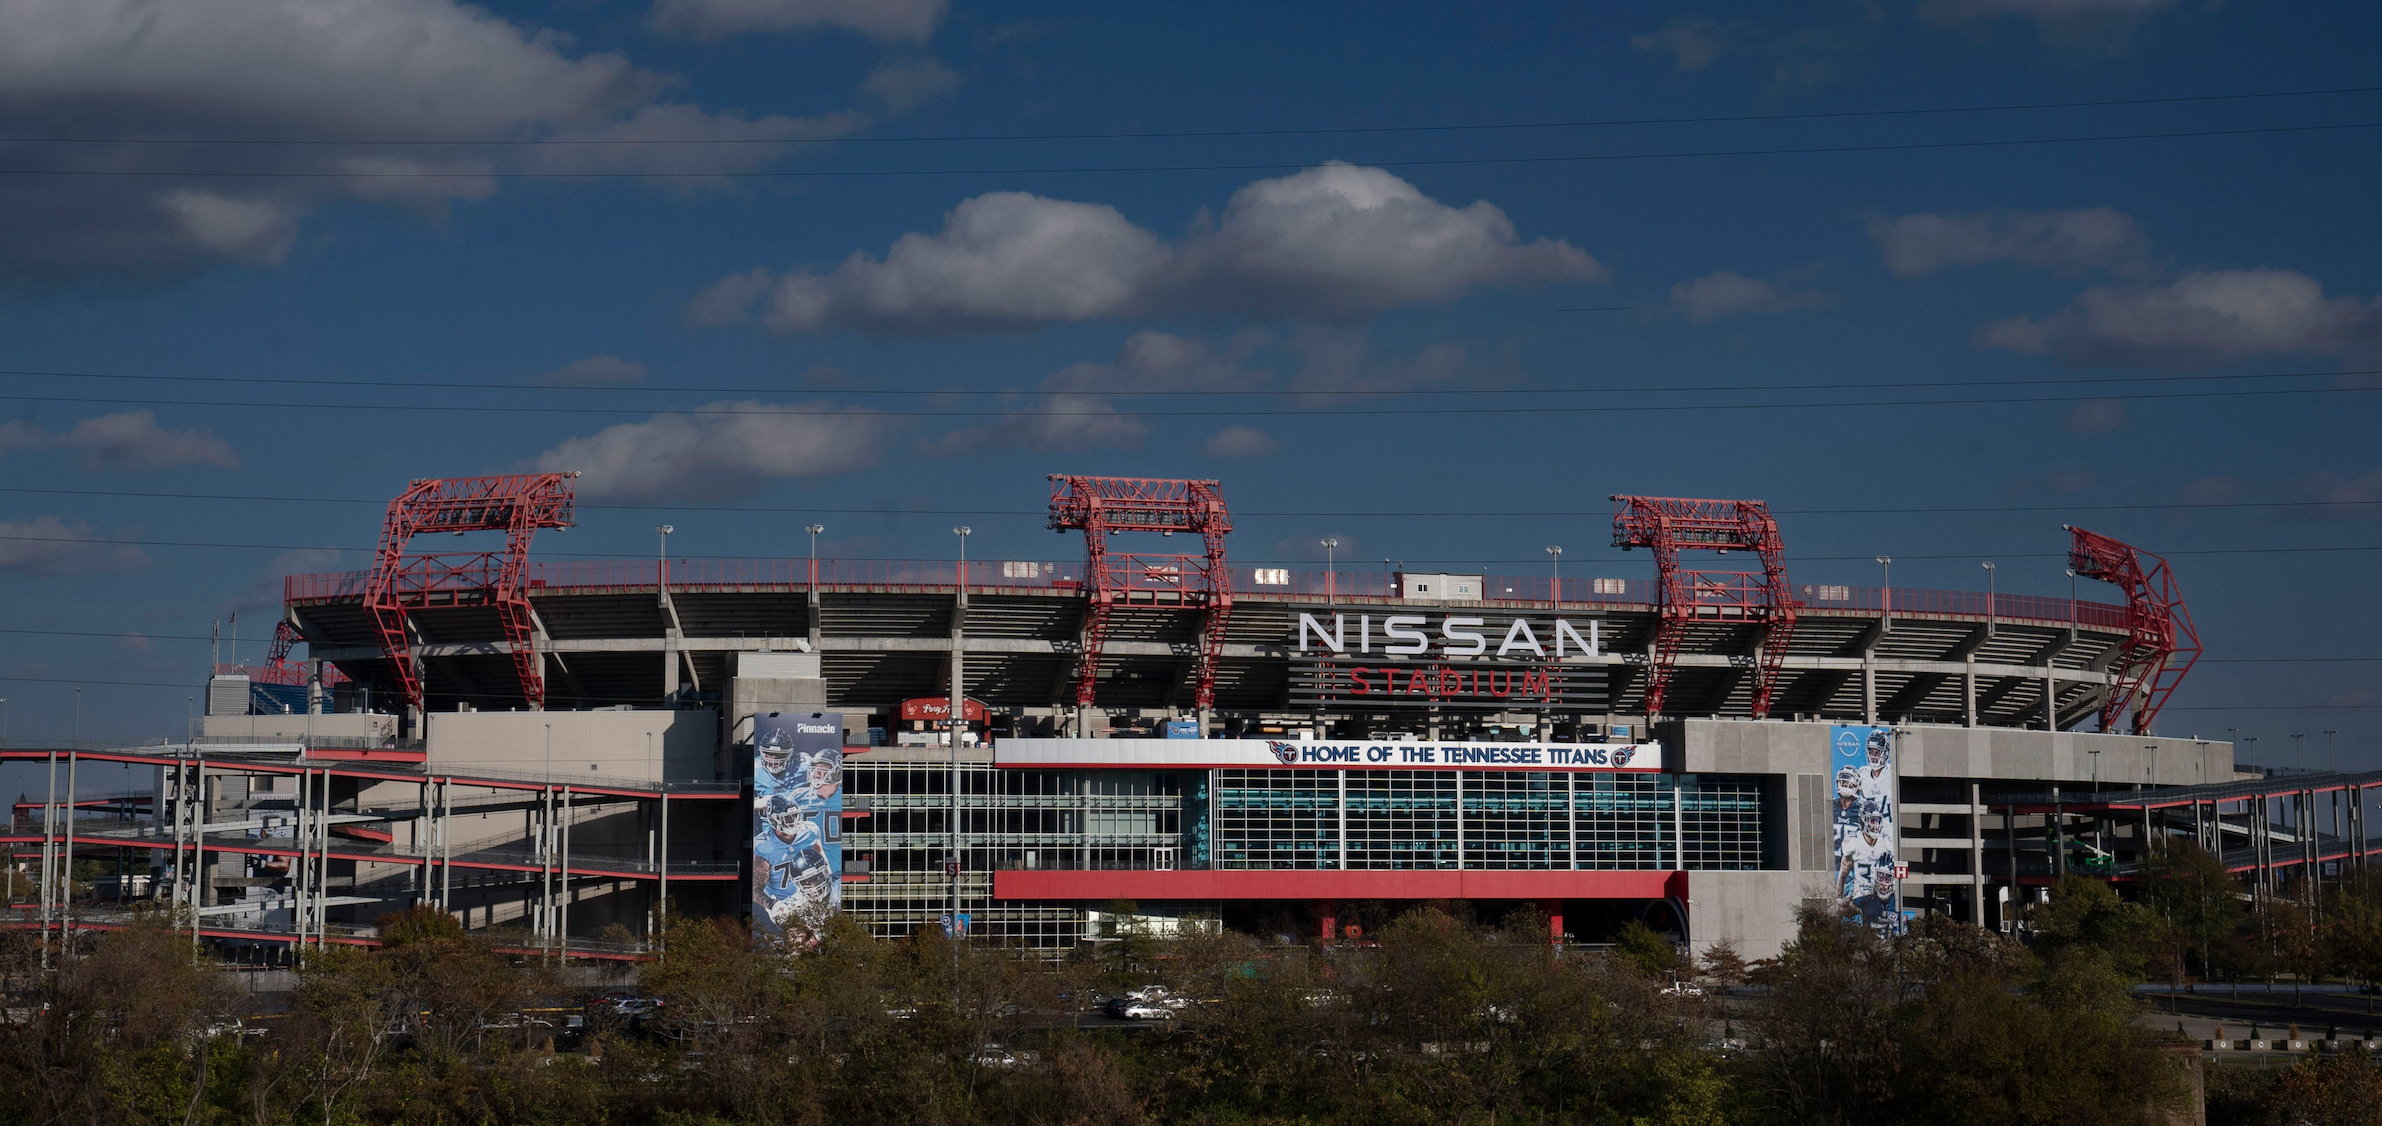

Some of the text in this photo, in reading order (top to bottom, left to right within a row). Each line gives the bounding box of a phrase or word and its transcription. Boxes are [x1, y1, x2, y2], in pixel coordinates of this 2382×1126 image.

[1300, 613, 1599, 657] NISSAN
[1350, 667, 1551, 698] STADIUM
[797, 722, 836, 734] Pinnacle
[1302, 746, 1608, 765] HOME OF THE TENNESSEE TITANS
[773, 860, 791, 889] 7
[948, 863, 956, 875] S
[1896, 867, 1907, 878] H
